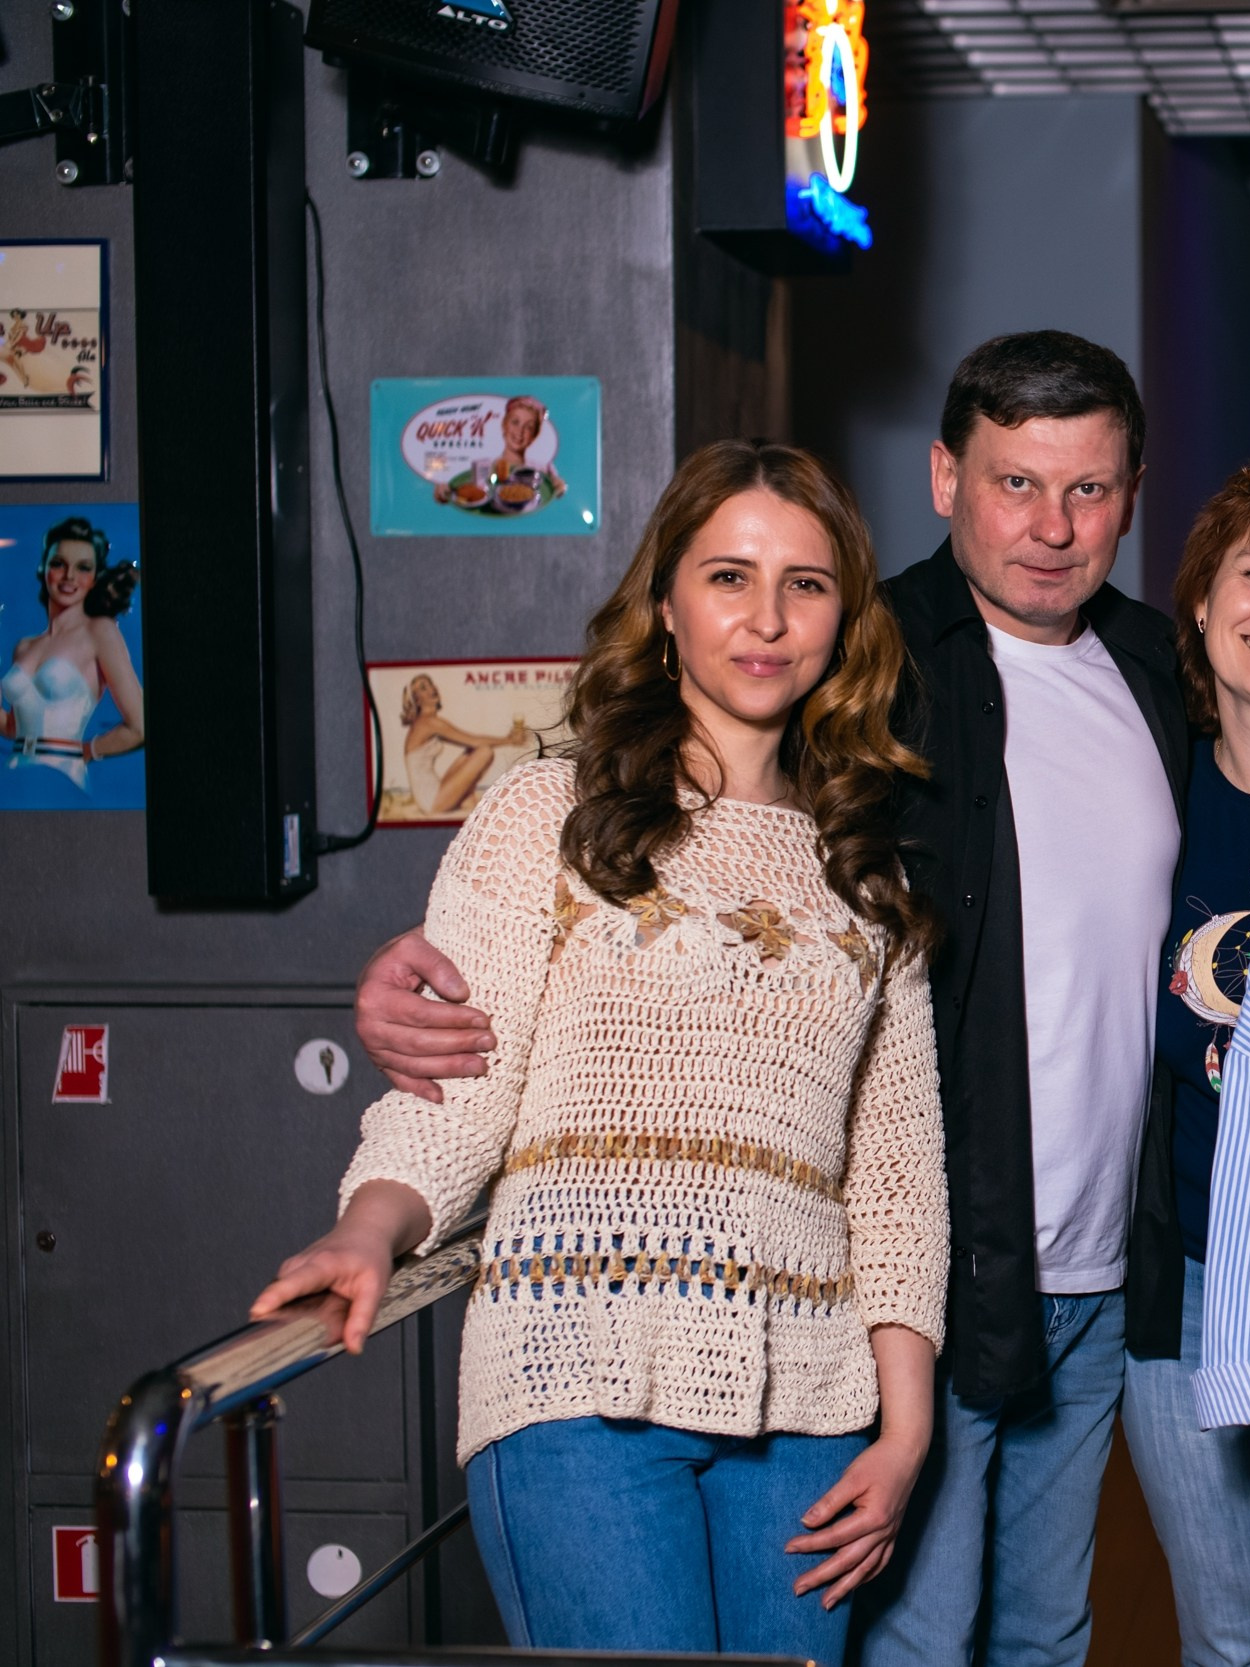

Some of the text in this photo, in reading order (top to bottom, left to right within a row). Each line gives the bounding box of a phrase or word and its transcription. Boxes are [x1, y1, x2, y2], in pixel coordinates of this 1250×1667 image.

[437, 4, 509, 30] ALTO
[35, 311, 71, 346] Up
[416, 419, 468, 443] QUICK
[464, 670, 528, 685] ANCRE
